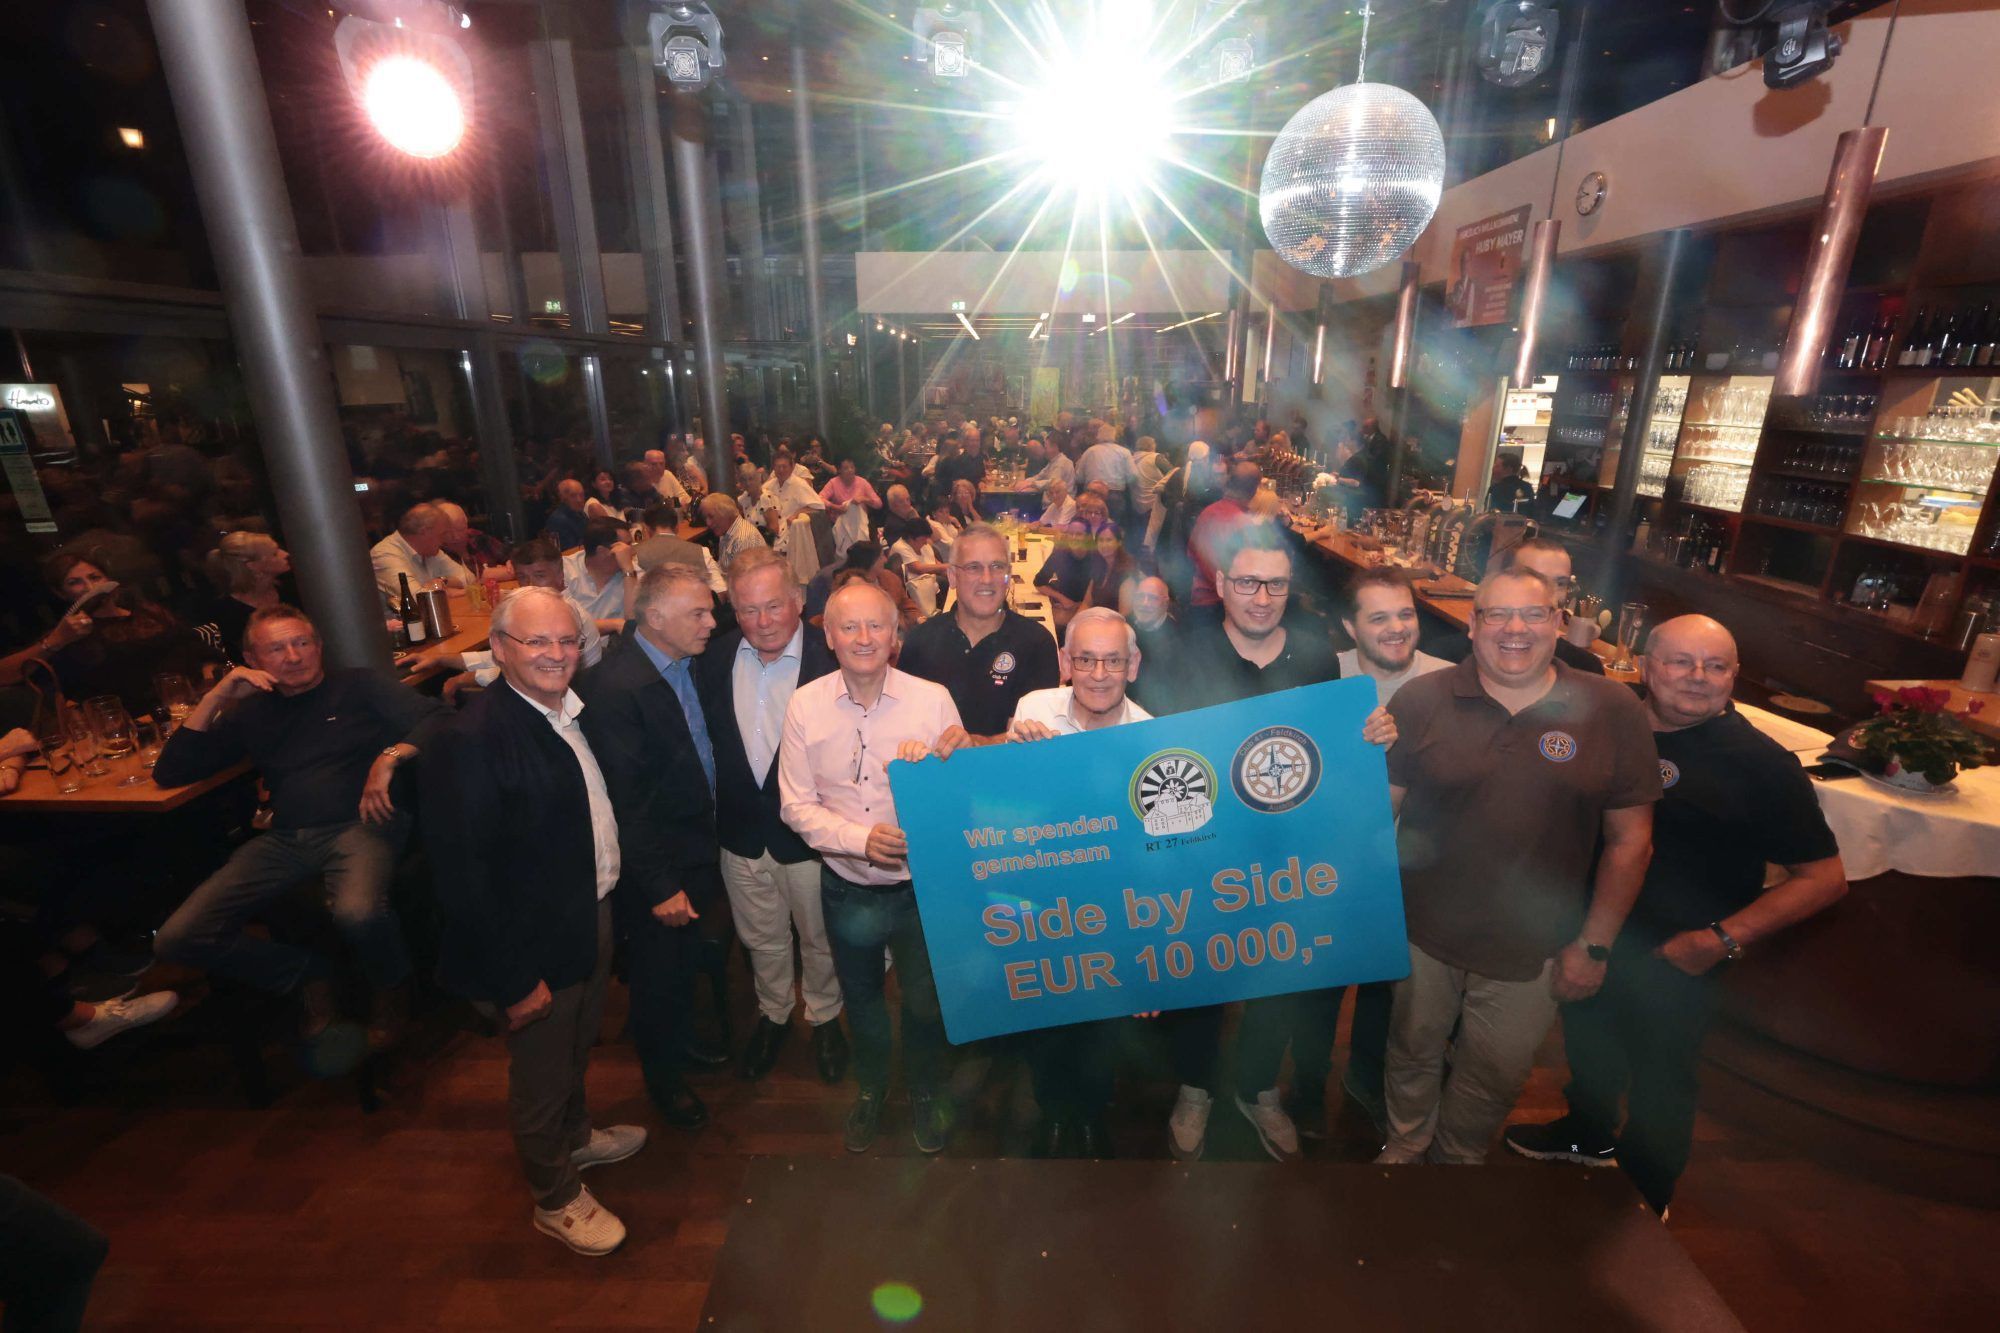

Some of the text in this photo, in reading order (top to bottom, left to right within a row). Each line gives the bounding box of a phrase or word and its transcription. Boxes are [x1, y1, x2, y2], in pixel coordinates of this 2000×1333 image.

[1270, 728, 1307, 746] Feldkirch
[963, 815, 1118, 848] Wir spenden
[1145, 832, 1217, 852] RT 27 Feldkirch
[972, 845, 1110, 880] gemeinsam
[982, 857, 1338, 946] Side by Side
[1004, 952, 1122, 1000] EUR
[1135, 941, 1194, 982] 10
